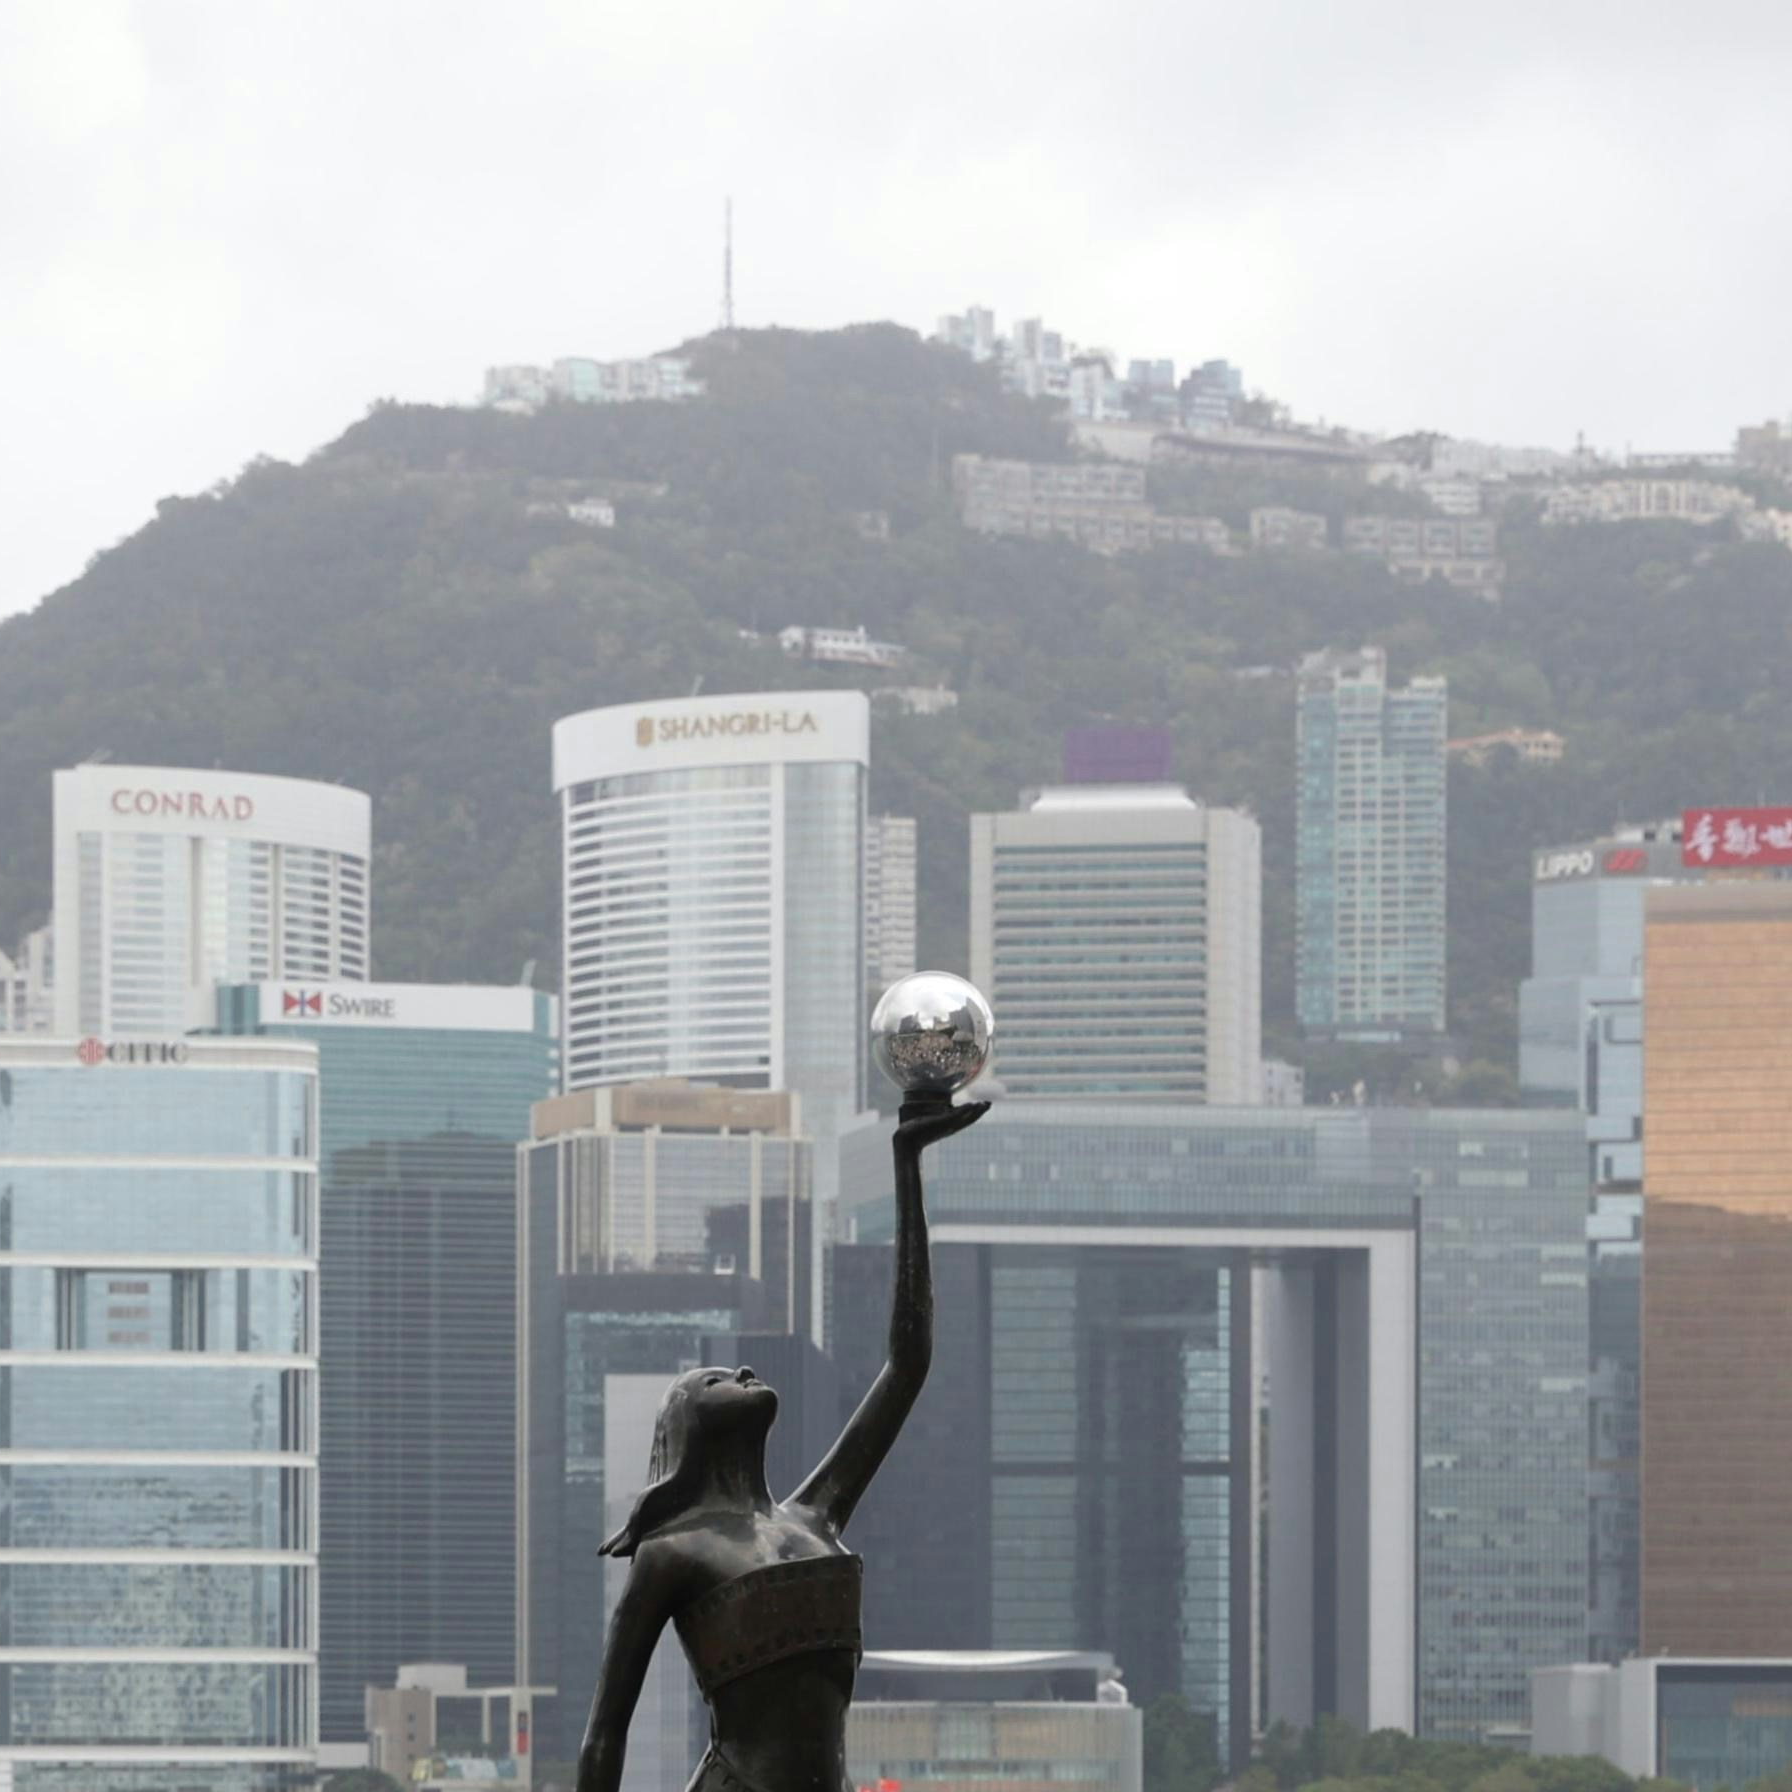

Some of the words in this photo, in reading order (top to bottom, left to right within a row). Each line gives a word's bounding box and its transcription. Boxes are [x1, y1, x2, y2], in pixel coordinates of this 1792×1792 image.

[659, 711, 818, 741] SHANGRI-LA
[111, 788, 255, 821] CONRAD
[1536, 851, 1595, 880] LIPPO
